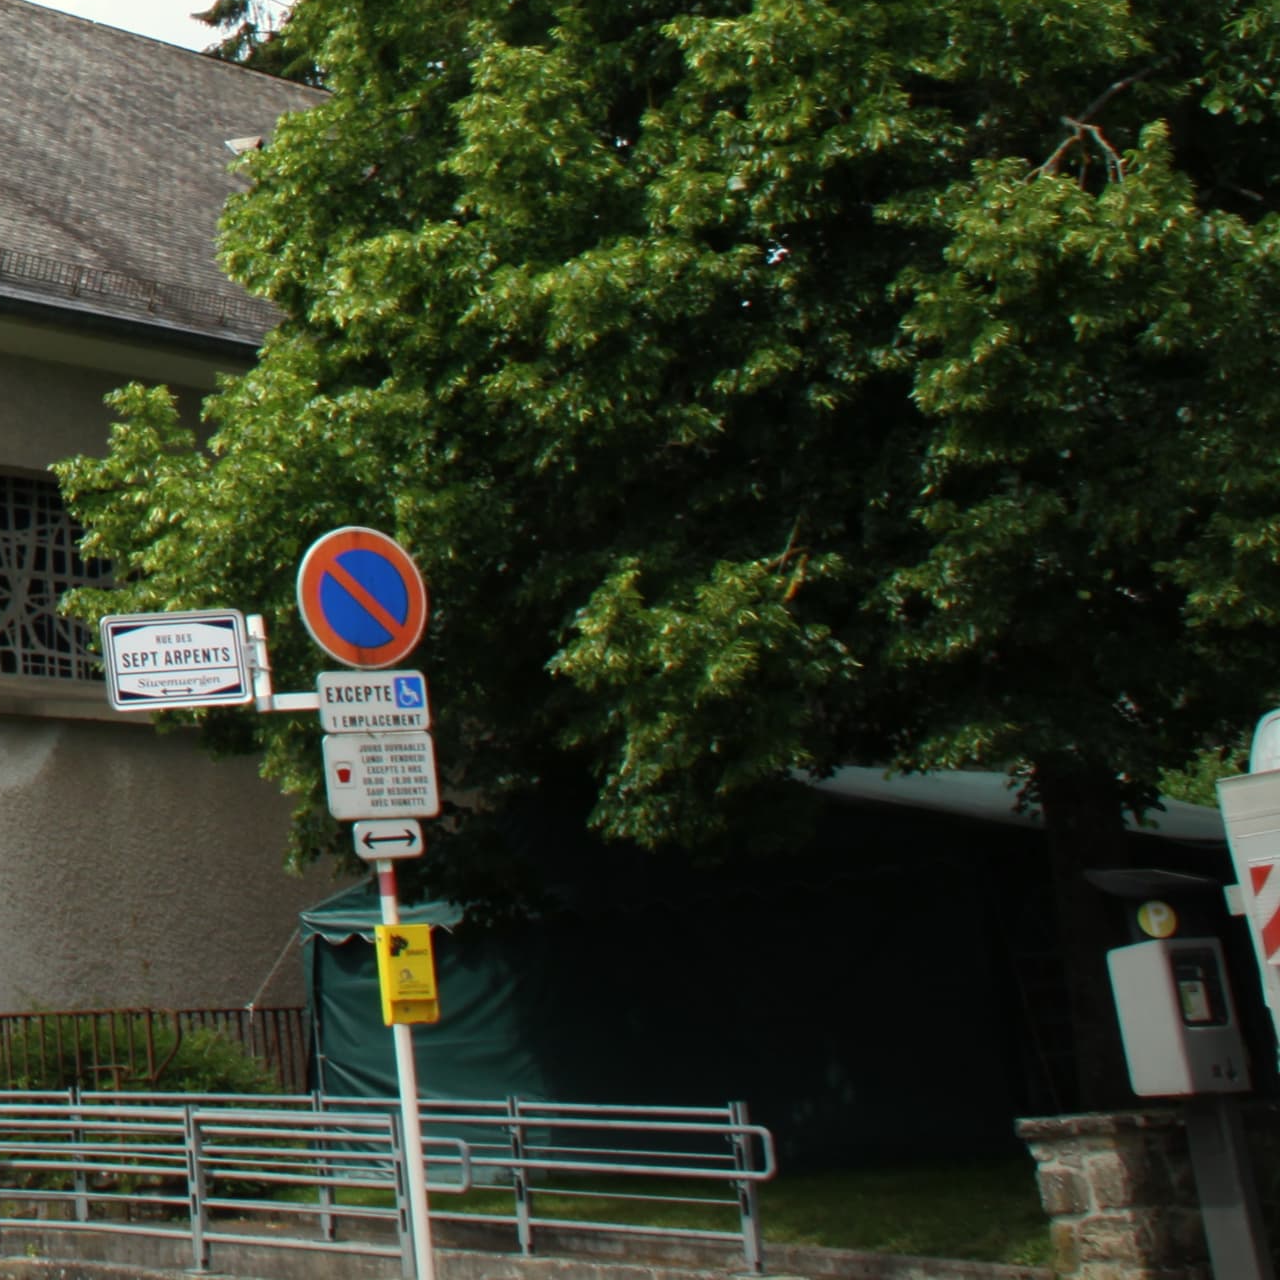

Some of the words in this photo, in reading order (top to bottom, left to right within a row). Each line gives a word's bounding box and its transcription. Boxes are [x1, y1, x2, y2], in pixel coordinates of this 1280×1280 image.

[155, 634, 172, 644] RUE
[175, 633, 192, 643] DES
[121, 651, 157, 668] SEPT
[164, 647, 231, 665] ARPENTS
[325, 685, 392, 703] EXCEPTE
[332, 716, 337, 728] 1
[342, 714, 421, 728] EMPLACEMENT
[1148, 902, 1168, 936] P
